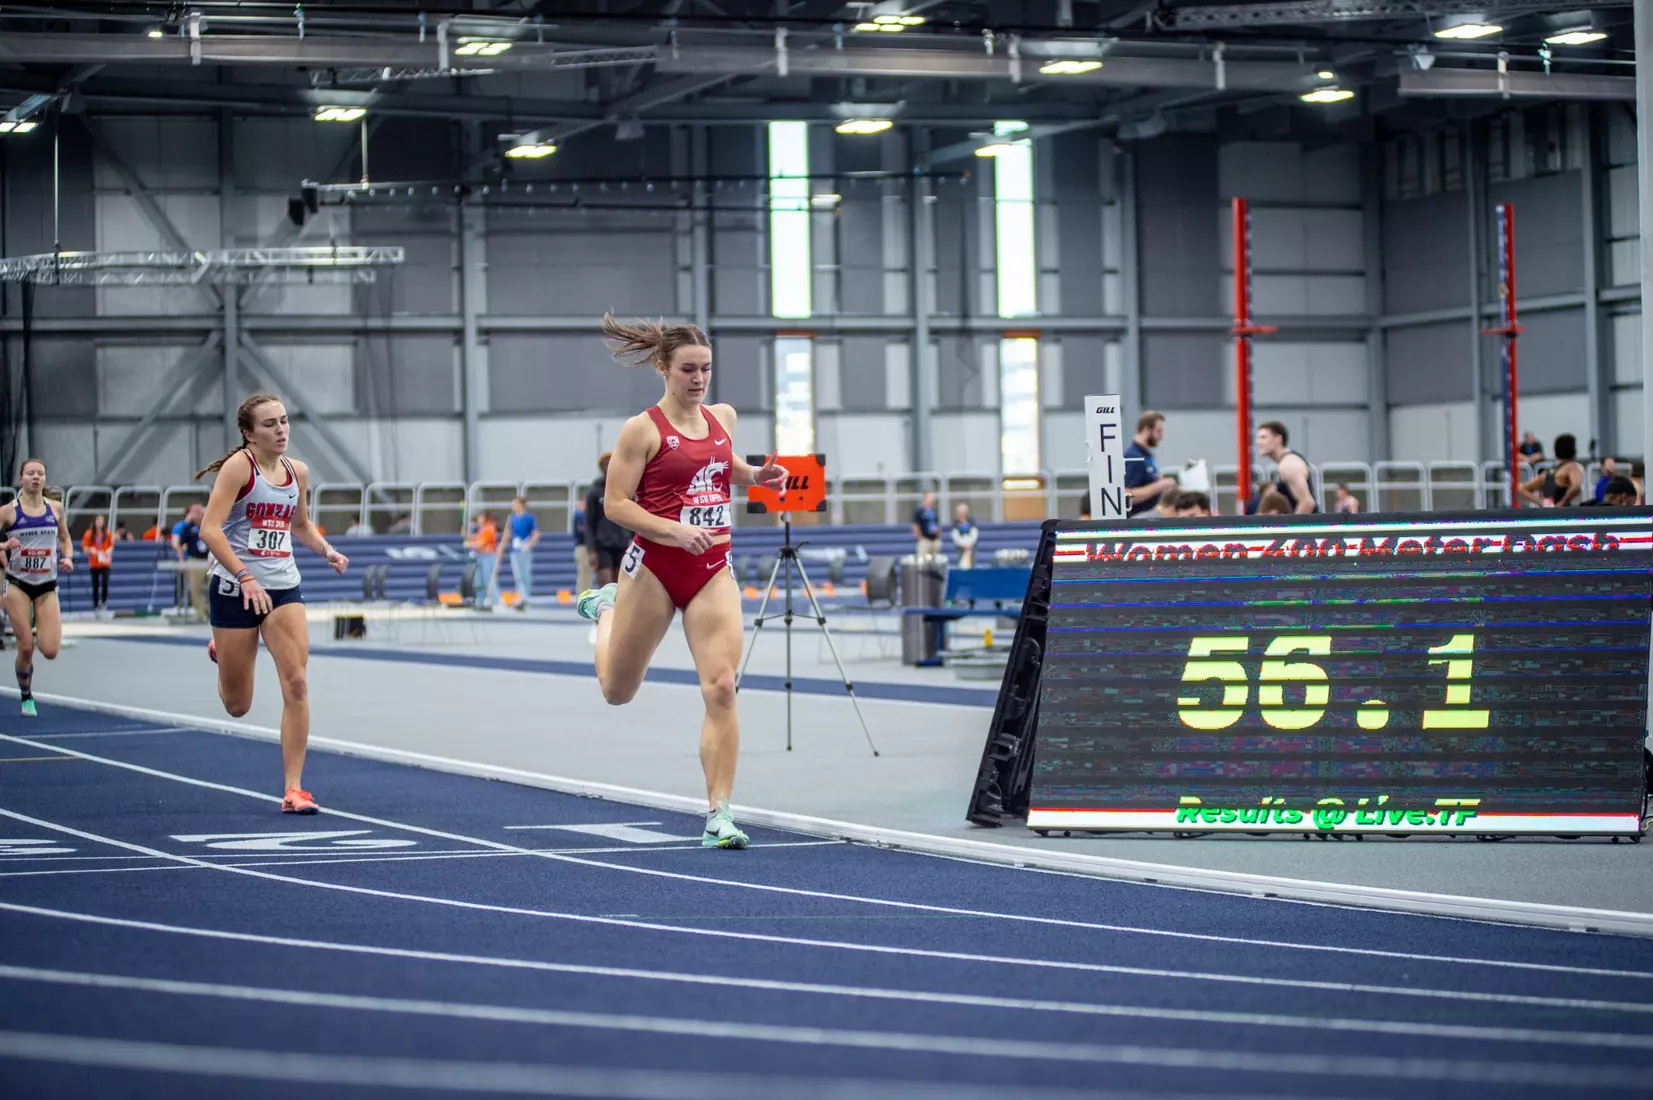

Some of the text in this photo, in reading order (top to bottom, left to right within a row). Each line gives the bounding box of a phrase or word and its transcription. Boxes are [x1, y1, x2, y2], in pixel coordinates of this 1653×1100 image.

[1096, 406, 1115, 414] GILL
[785, 475, 810, 490] ILL
[689, 505, 725, 527] 842
[256, 529, 286, 550] 307
[25, 557, 47, 569] 887
[624, 545, 641, 573] 5
[1177, 634, 1490, 730] 56.1
[1176, 796, 1304, 825] Results
